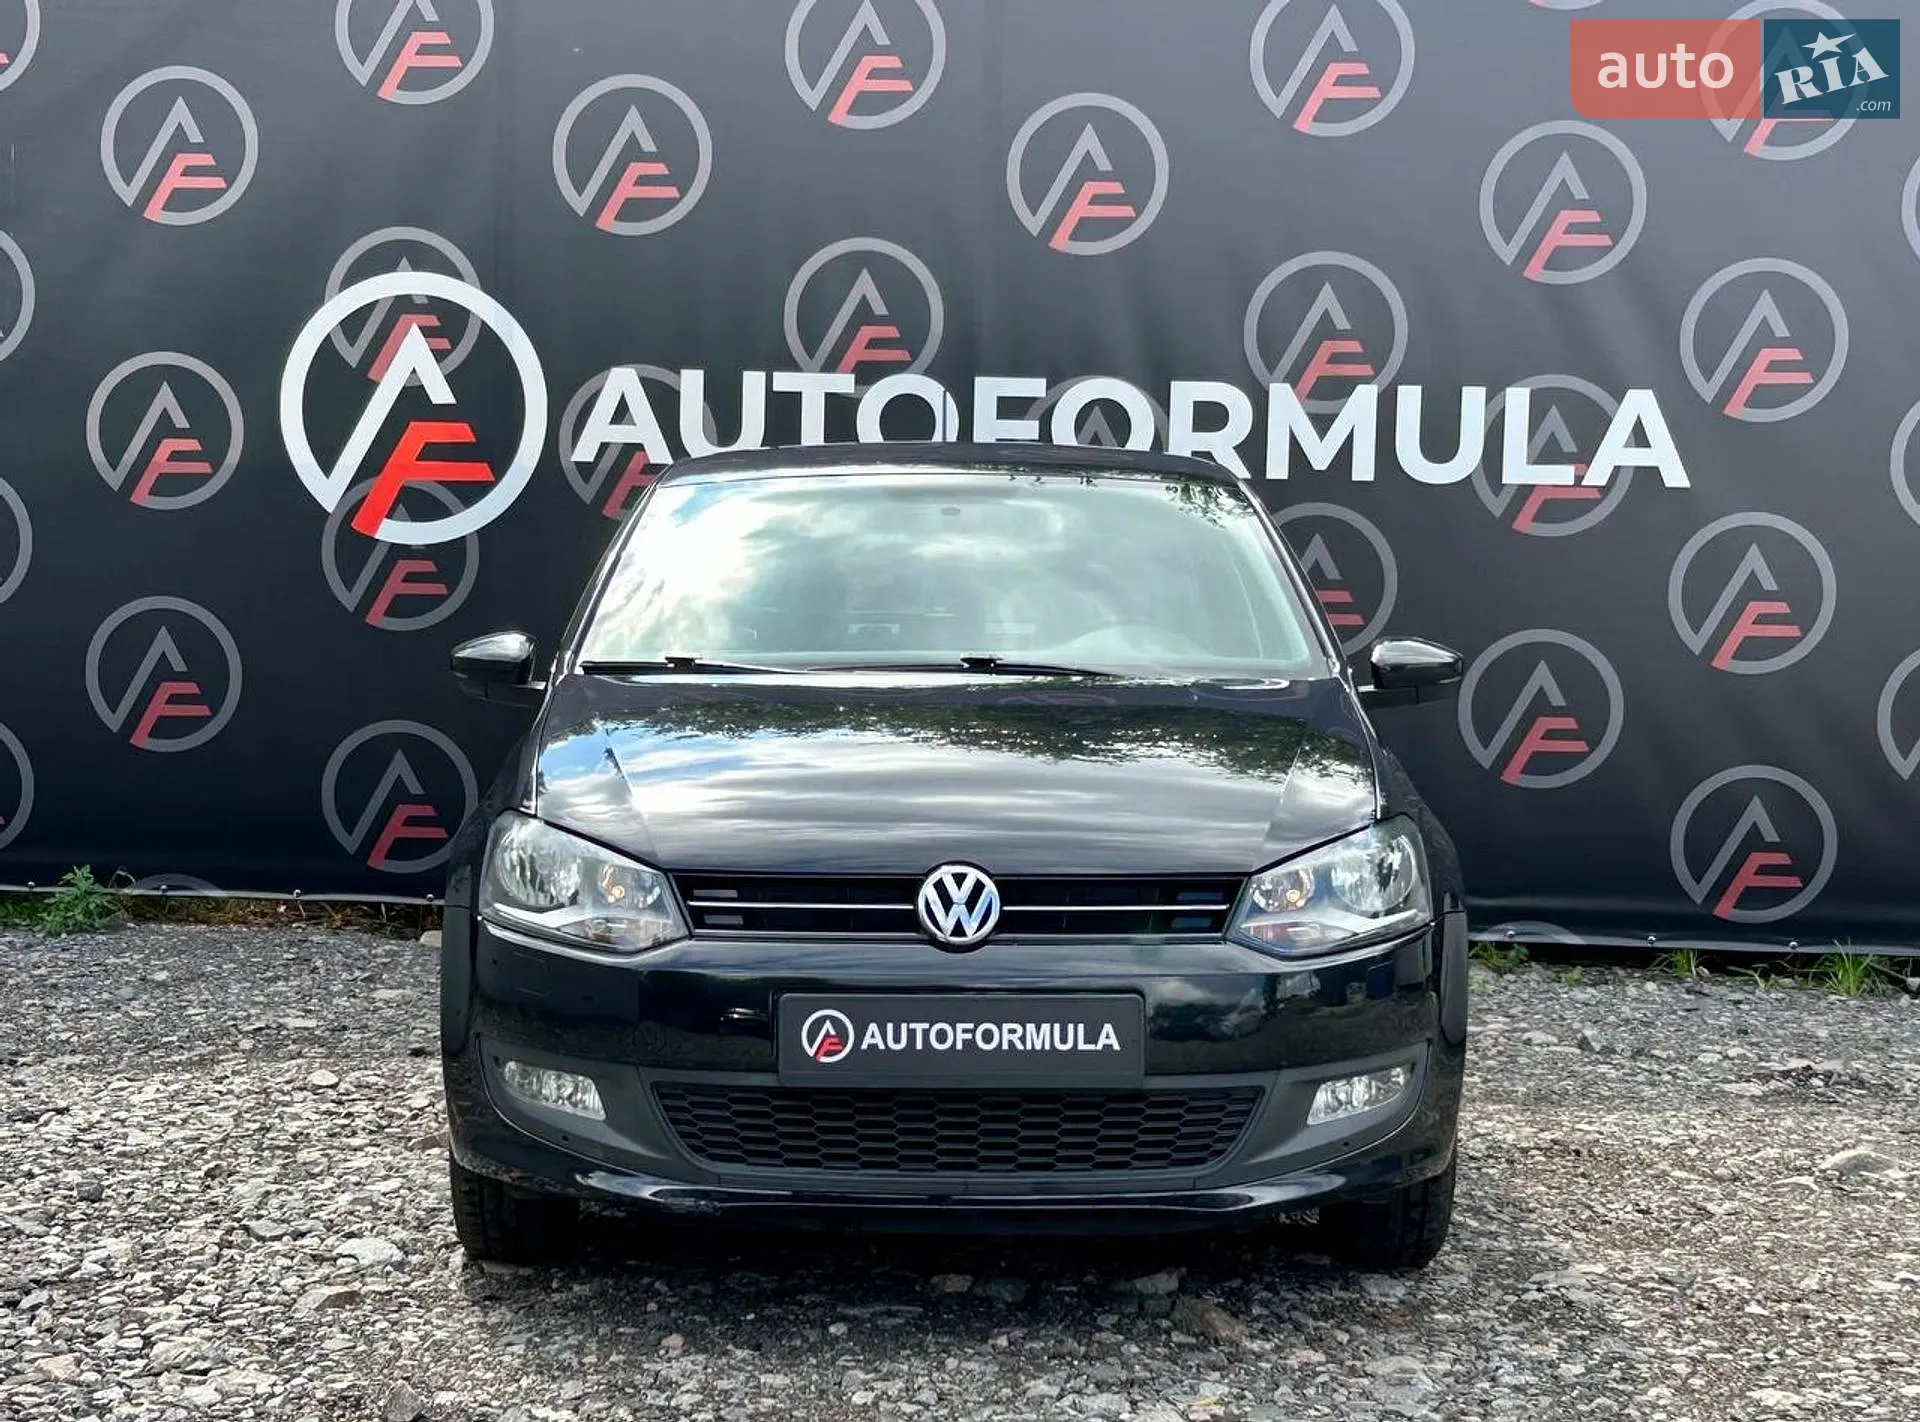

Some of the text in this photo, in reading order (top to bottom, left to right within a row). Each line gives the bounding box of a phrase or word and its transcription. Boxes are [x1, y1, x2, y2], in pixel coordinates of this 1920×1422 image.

[571, 368, 1692, 488] AUTOFORMULA
[921, 869, 997, 939] VW
[860, 1021, 1121, 1051] AUTOFORMULA
